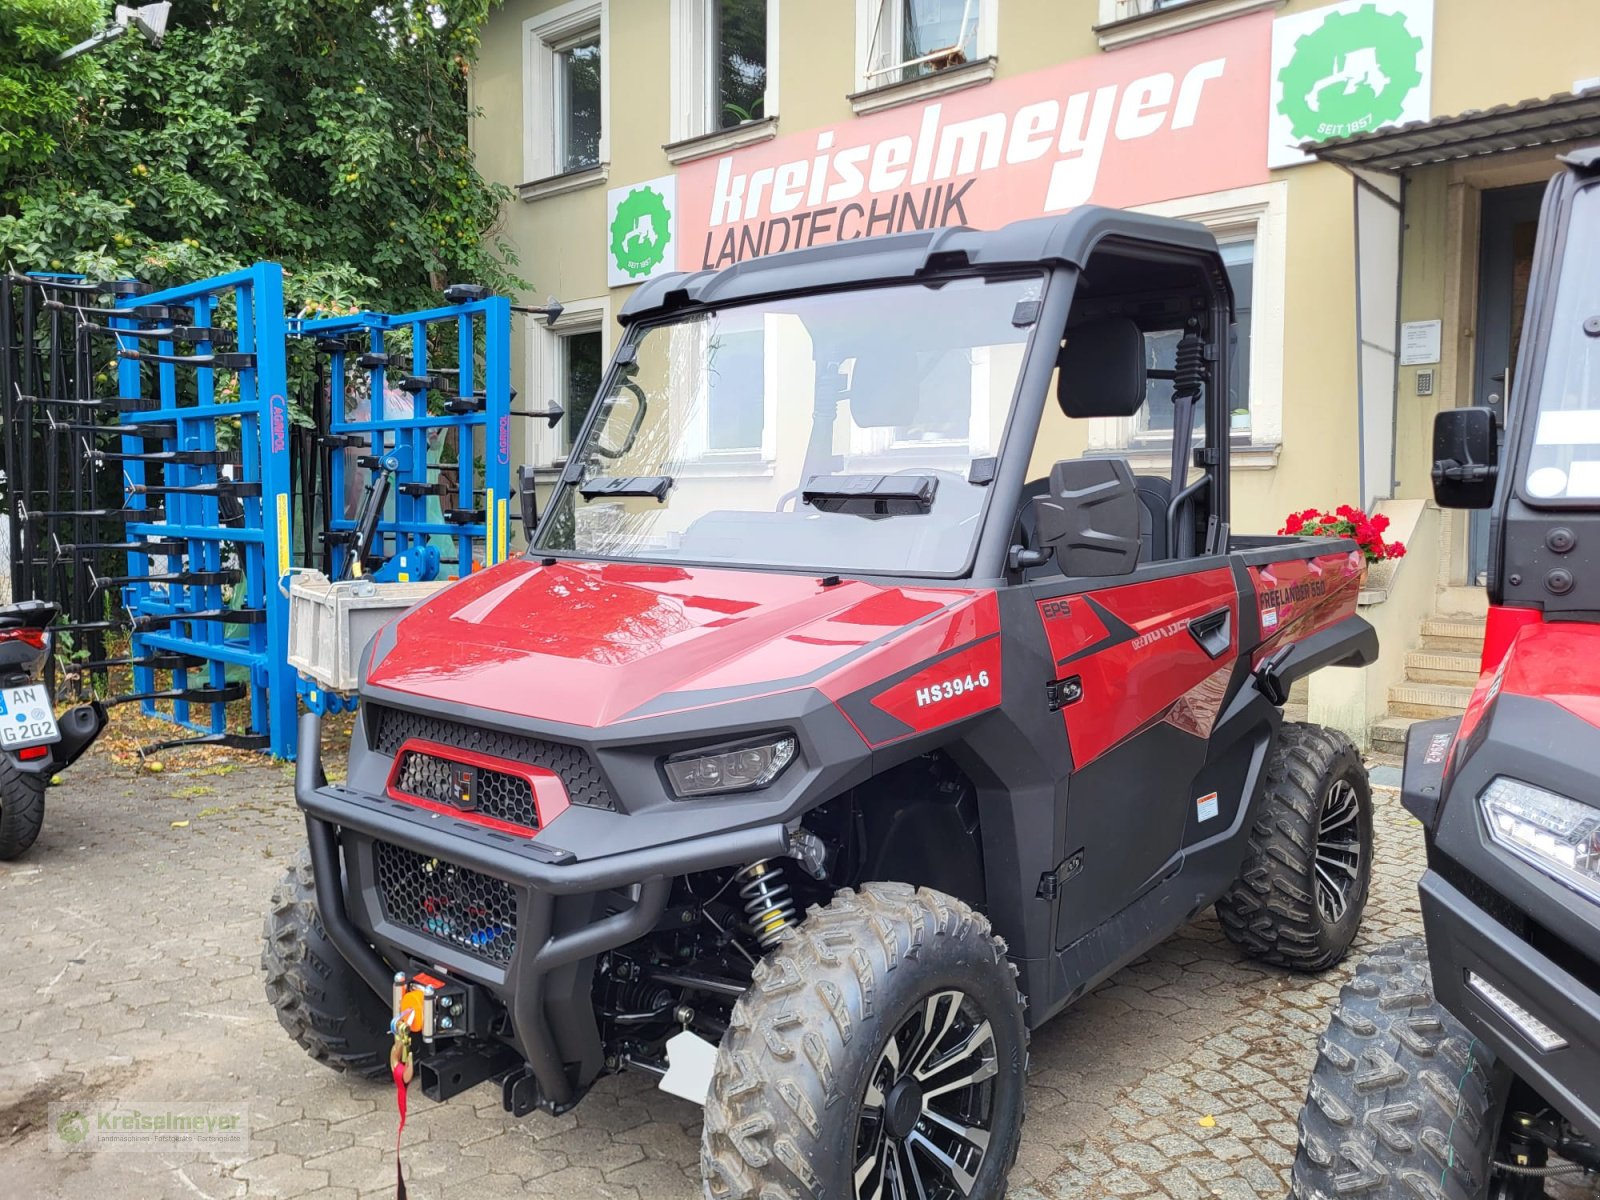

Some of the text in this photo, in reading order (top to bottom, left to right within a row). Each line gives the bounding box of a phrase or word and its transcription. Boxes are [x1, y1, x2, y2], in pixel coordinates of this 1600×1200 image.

[1317, 112, 1373, 135] SEIT 1857
[709, 57, 1226, 226] kreiselmeyer
[701, 178, 978, 271] LANDTECHNIK
[1260, 583, 1310, 608] FREELANDER
[1042, 600, 1071, 619] EPS
[13, 688, 37, 705] AN
[916, 670, 990, 707] HS394-6
[3, 721, 55, 742] G 202
